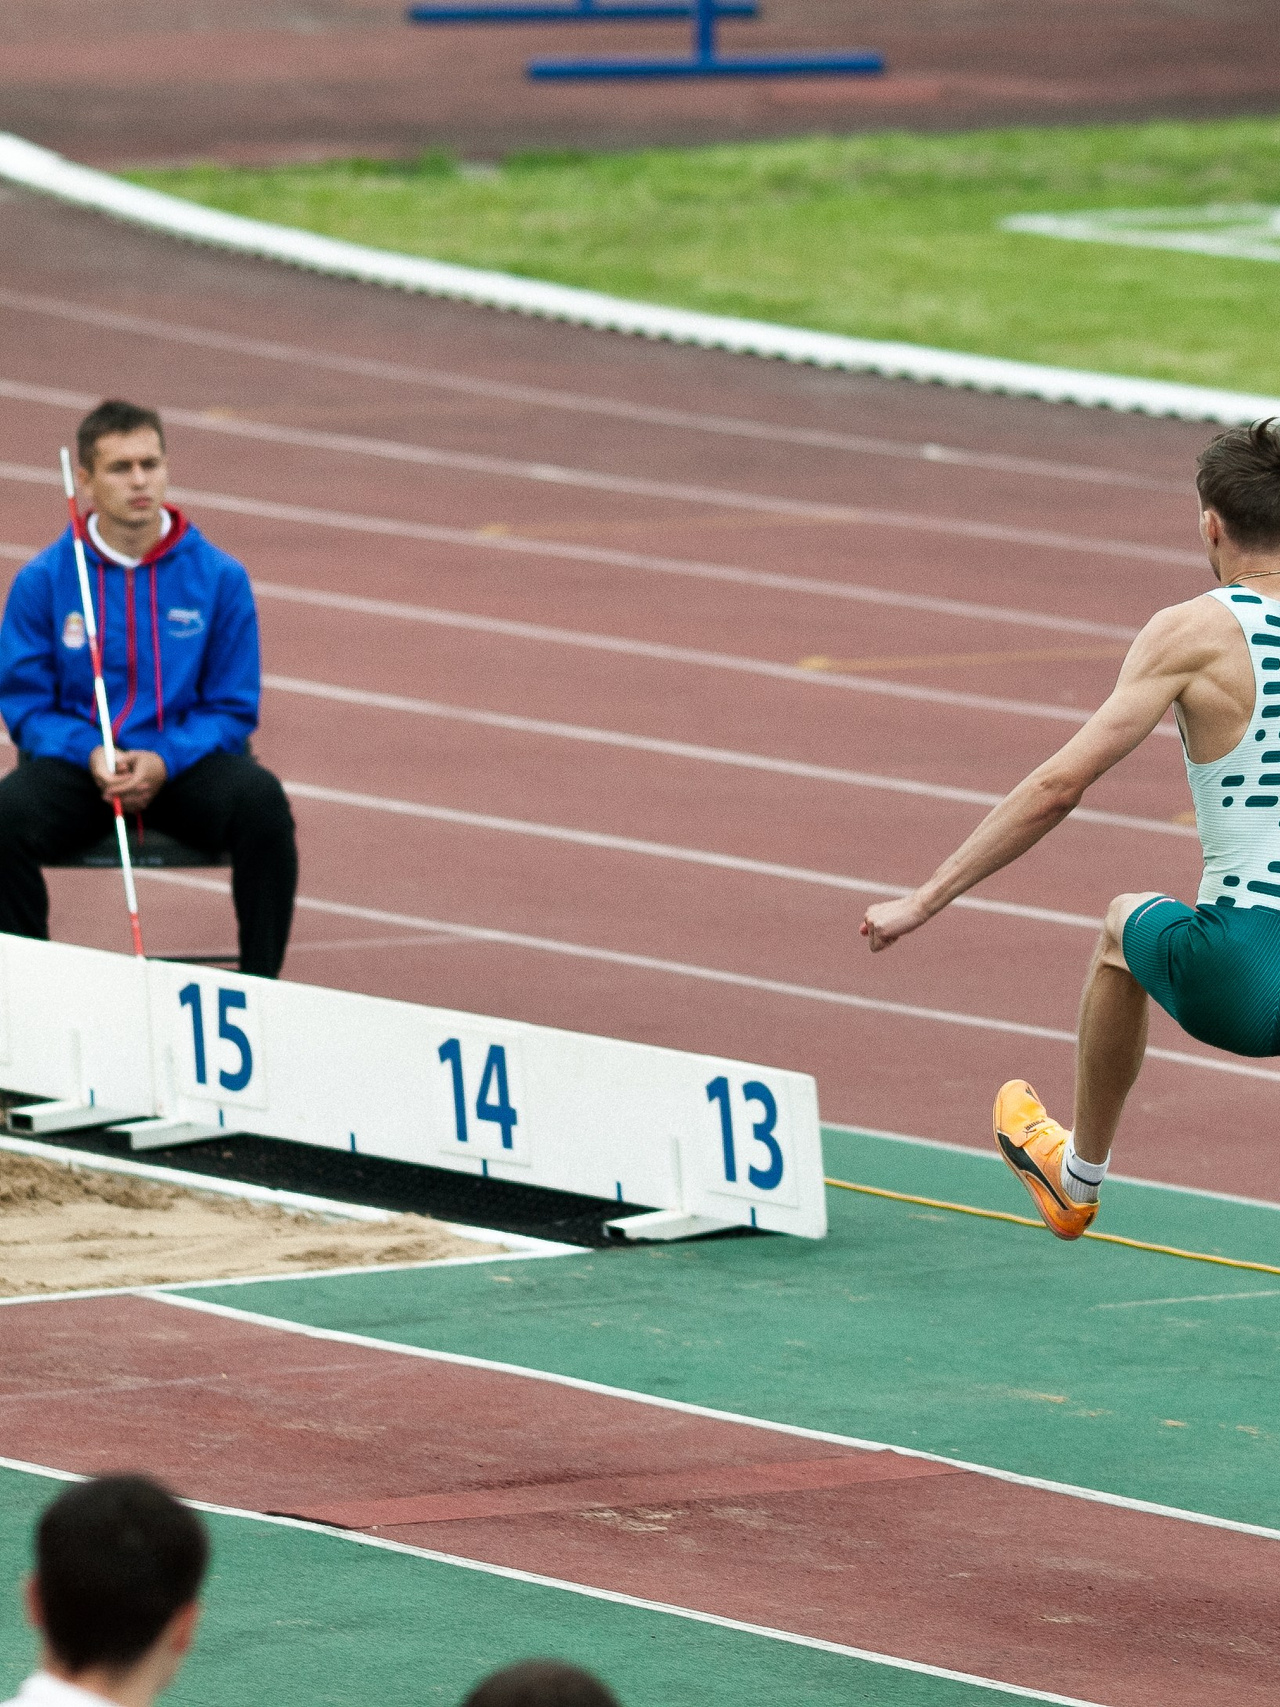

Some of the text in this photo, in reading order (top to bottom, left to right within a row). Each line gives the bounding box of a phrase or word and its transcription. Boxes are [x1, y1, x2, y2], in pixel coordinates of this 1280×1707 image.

[178, 983, 253, 1091] 15
[438, 1037, 518, 1150] 14
[705, 1075, 784, 1190] 13
